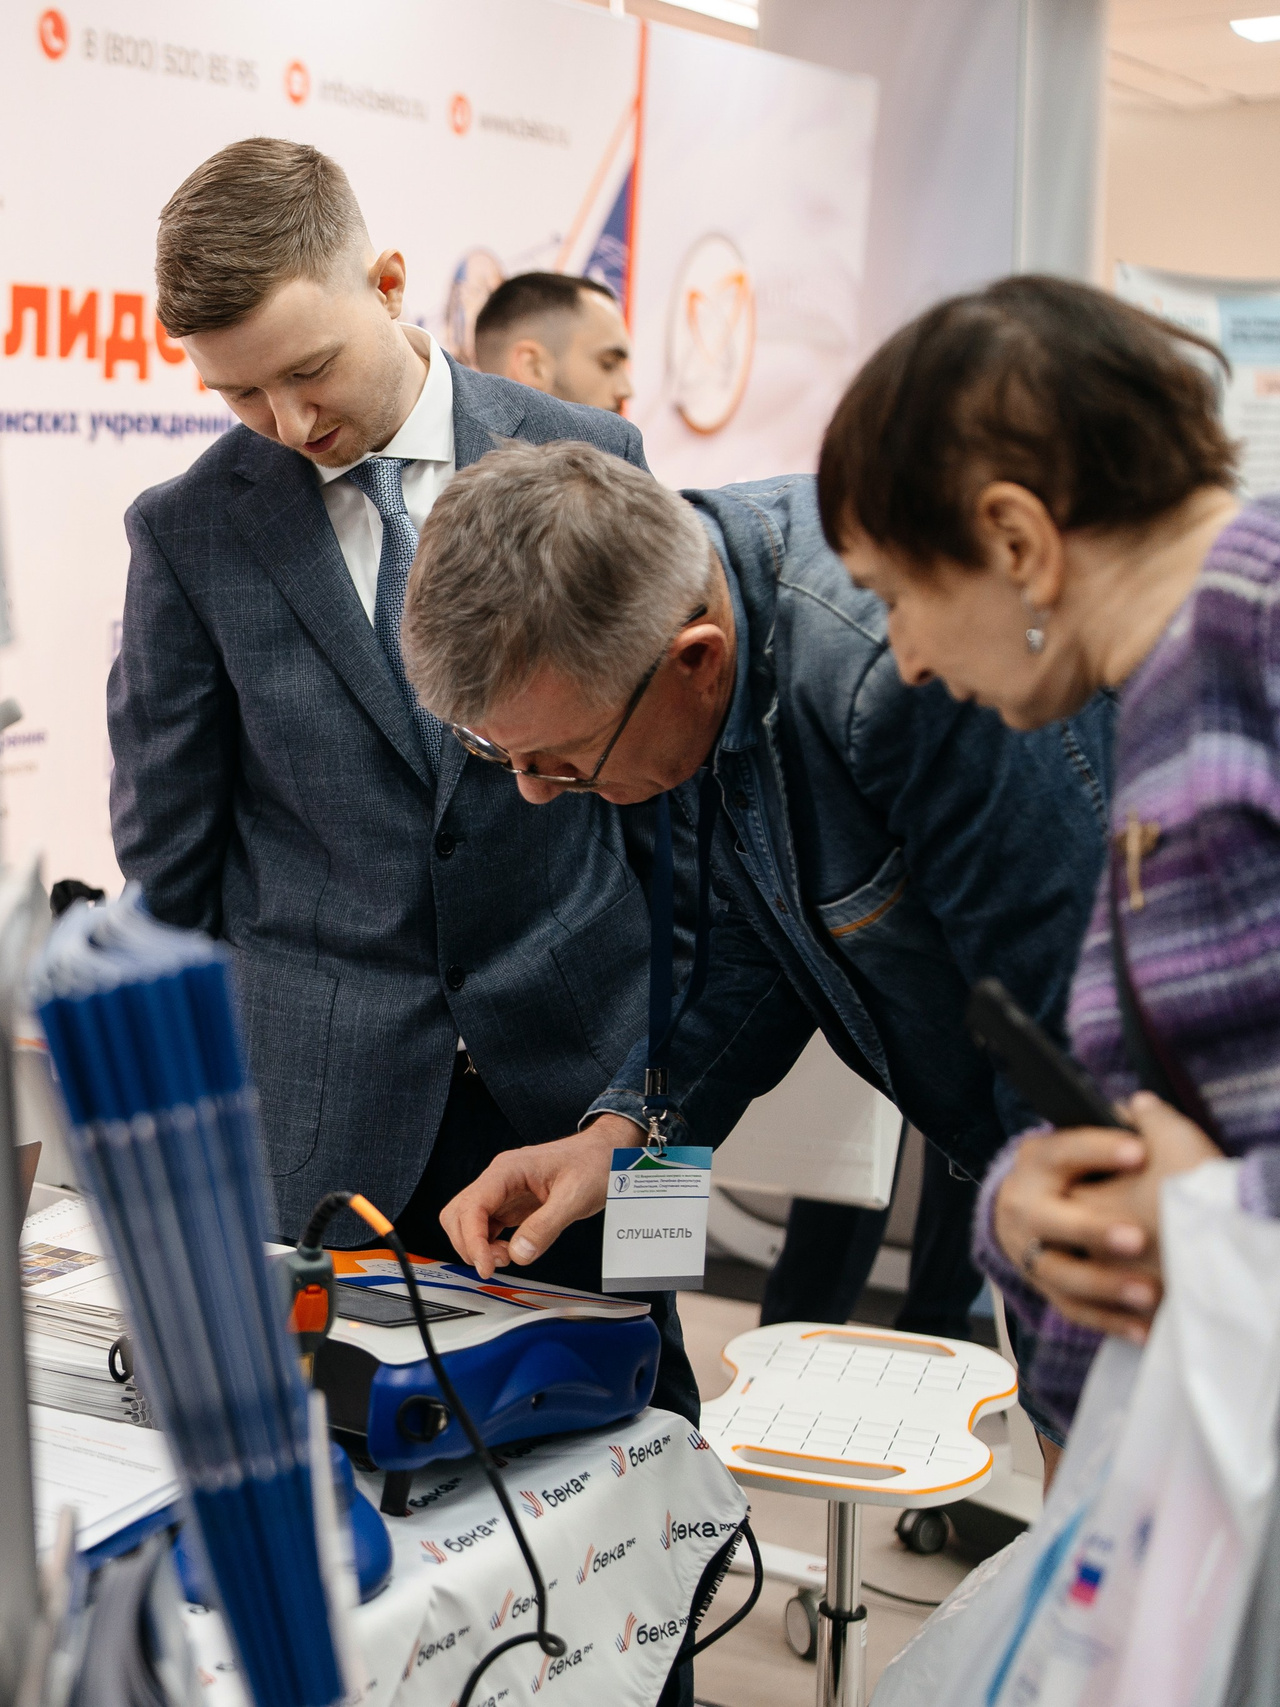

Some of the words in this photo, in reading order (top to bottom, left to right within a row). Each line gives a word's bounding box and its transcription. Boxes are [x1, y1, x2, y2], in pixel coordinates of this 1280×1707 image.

[3, 282, 207, 392] лиде
[88, 408, 238, 442] учреждени
[616, 1227, 693, 1240] СЛУШАТЕЛЬ
